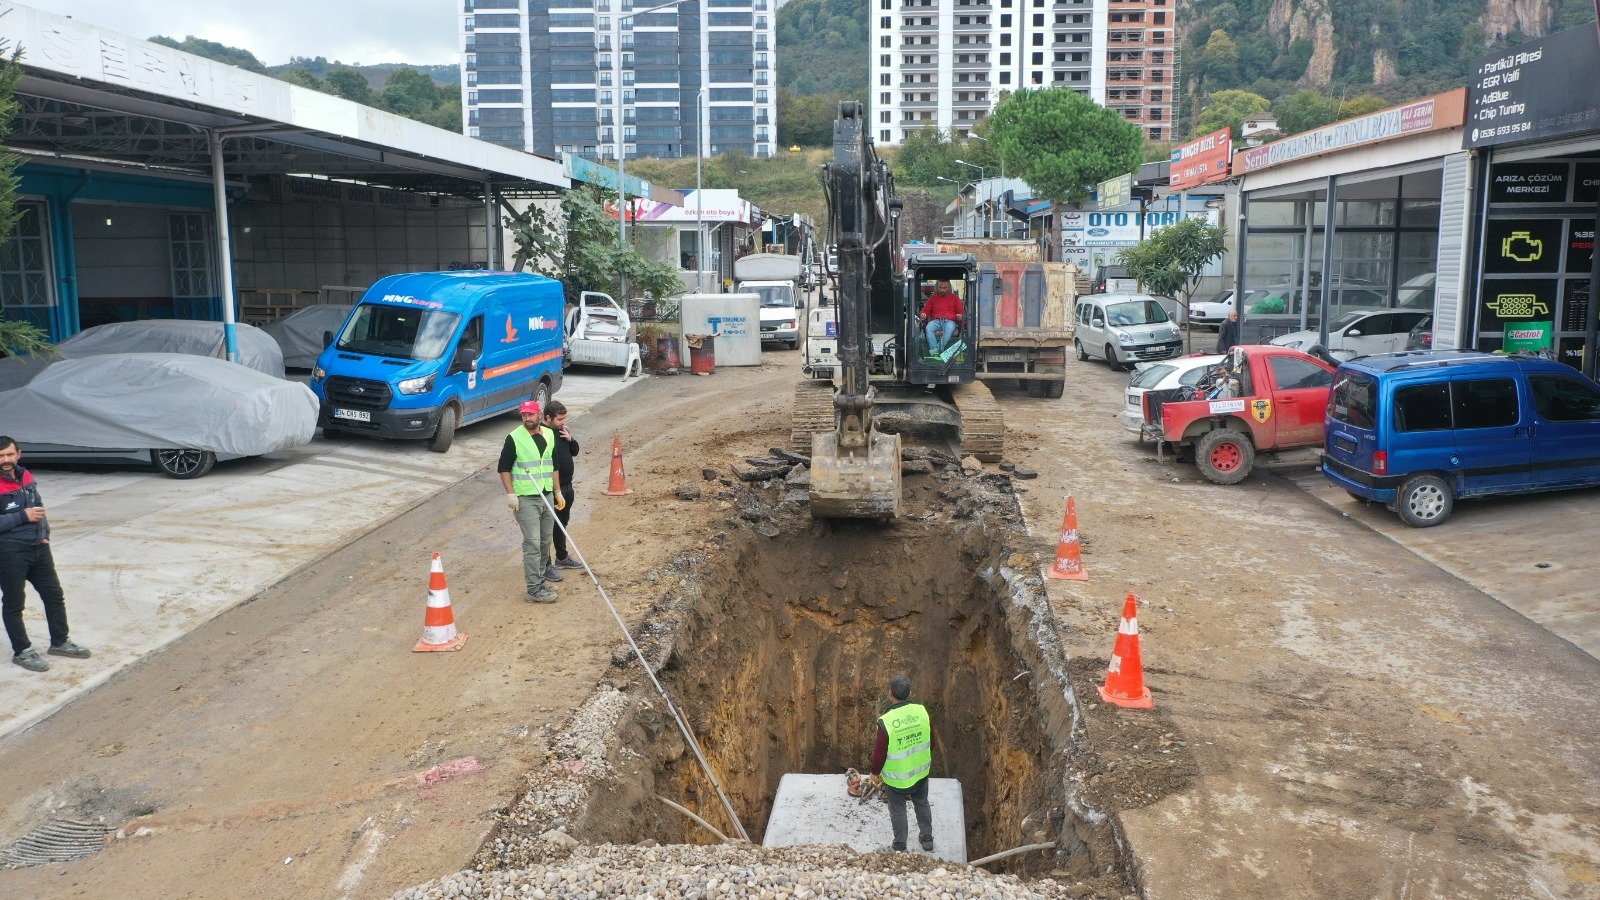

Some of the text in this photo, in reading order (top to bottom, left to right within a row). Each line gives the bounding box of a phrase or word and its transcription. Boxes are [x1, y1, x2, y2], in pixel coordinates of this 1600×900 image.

[1484, 47, 1543, 74] Partikül Filtresi
[1483, 68, 1520, 89] EGR Valfi
[1481, 91, 1509, 105] AdBlue
[1480, 102, 1525, 120] Chip Tuning
[1480, 128, 1495, 138] 0536
[1497, 125, 1510, 136] 693
[1245, 150, 1268, 169] Serin
[1527, 174, 1562, 184] ÇÖZÜM
[1506, 185, 1550, 193] MERKEZİ
[1088, 212, 1128, 226] OTO
[1514, 330, 1540, 338] Castrol
[1211, 401, 1243, 409] YILDIRIM
